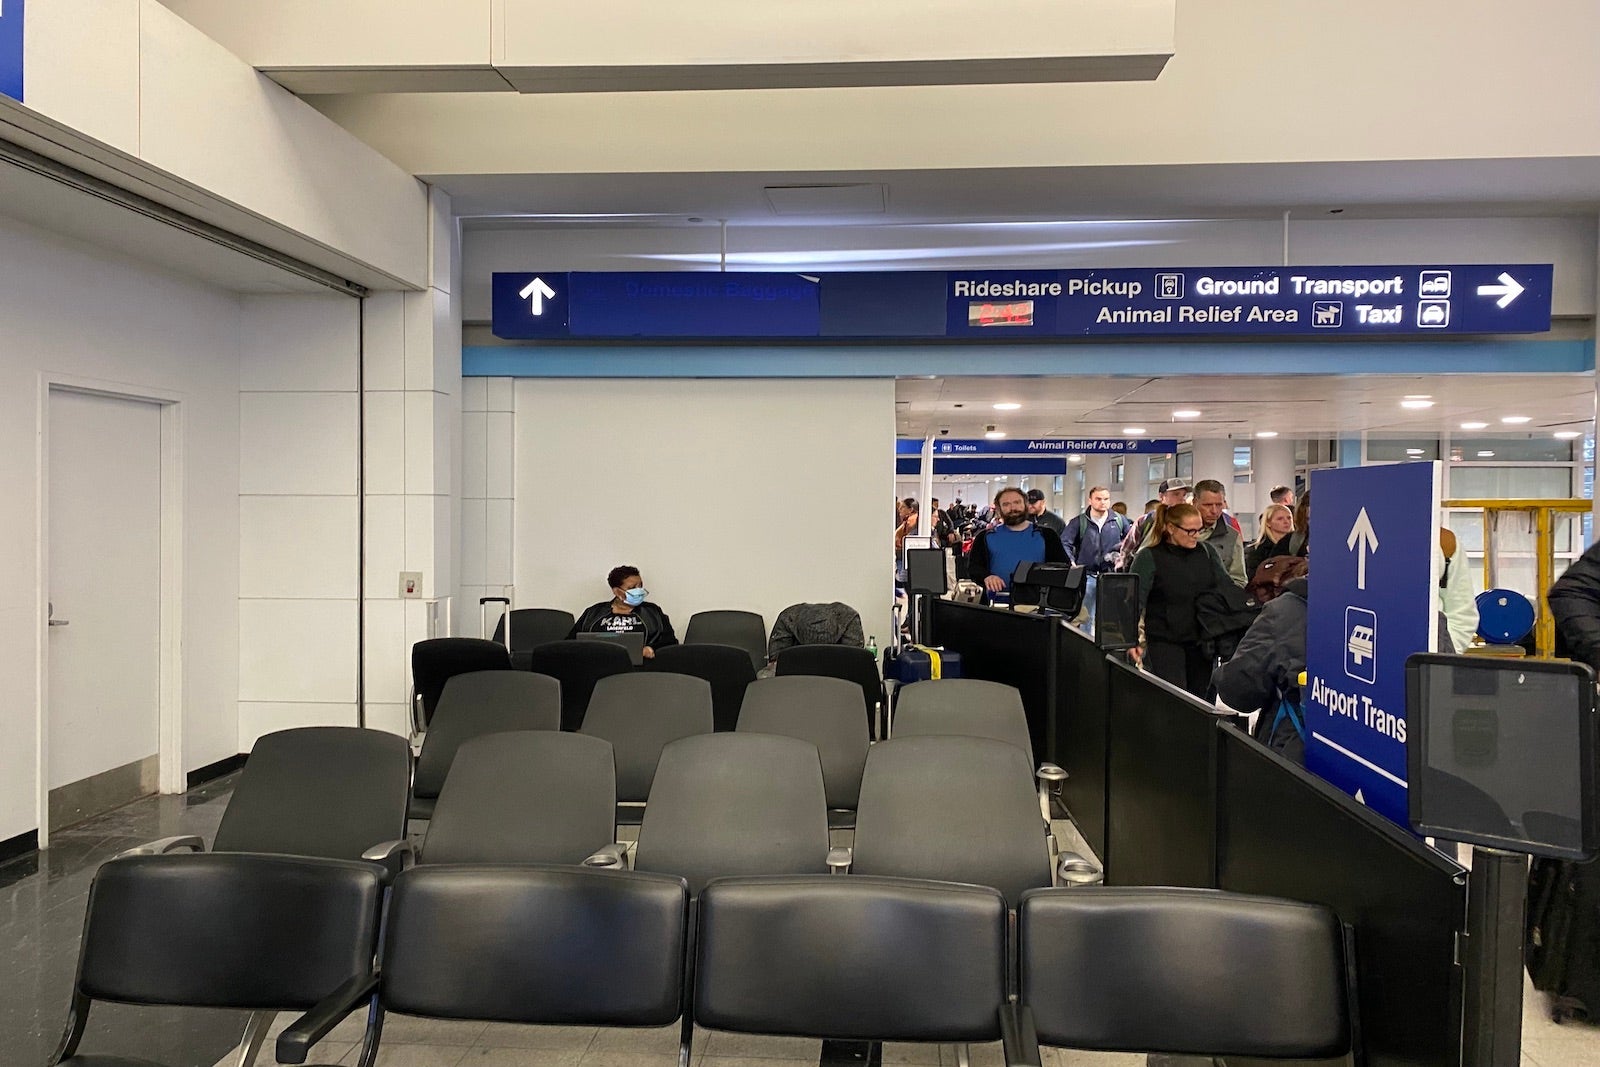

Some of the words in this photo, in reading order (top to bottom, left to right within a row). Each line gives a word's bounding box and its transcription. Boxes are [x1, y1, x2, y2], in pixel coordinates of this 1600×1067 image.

[954, 280, 1062, 297] Rideshare
[1068, 279, 1142, 298] Pickup
[1195, 276, 1280, 296] Ground
[1290, 276, 1404, 298] Transport
[1096, 306, 1172, 323] Animal
[1178, 306, 1242, 323] Relief
[1246, 306, 1299, 323] Area
[1355, 304, 1403, 324] Taxi
[954, 444, 977, 452] Toilets
[1027, 440, 1065, 450] Animal
[1066, 440, 1098, 450] Relief
[1098, 440, 1124, 450] Area
[1311, 676, 1358, 721] Airport
[1361, 695, 1407, 744] Trans
